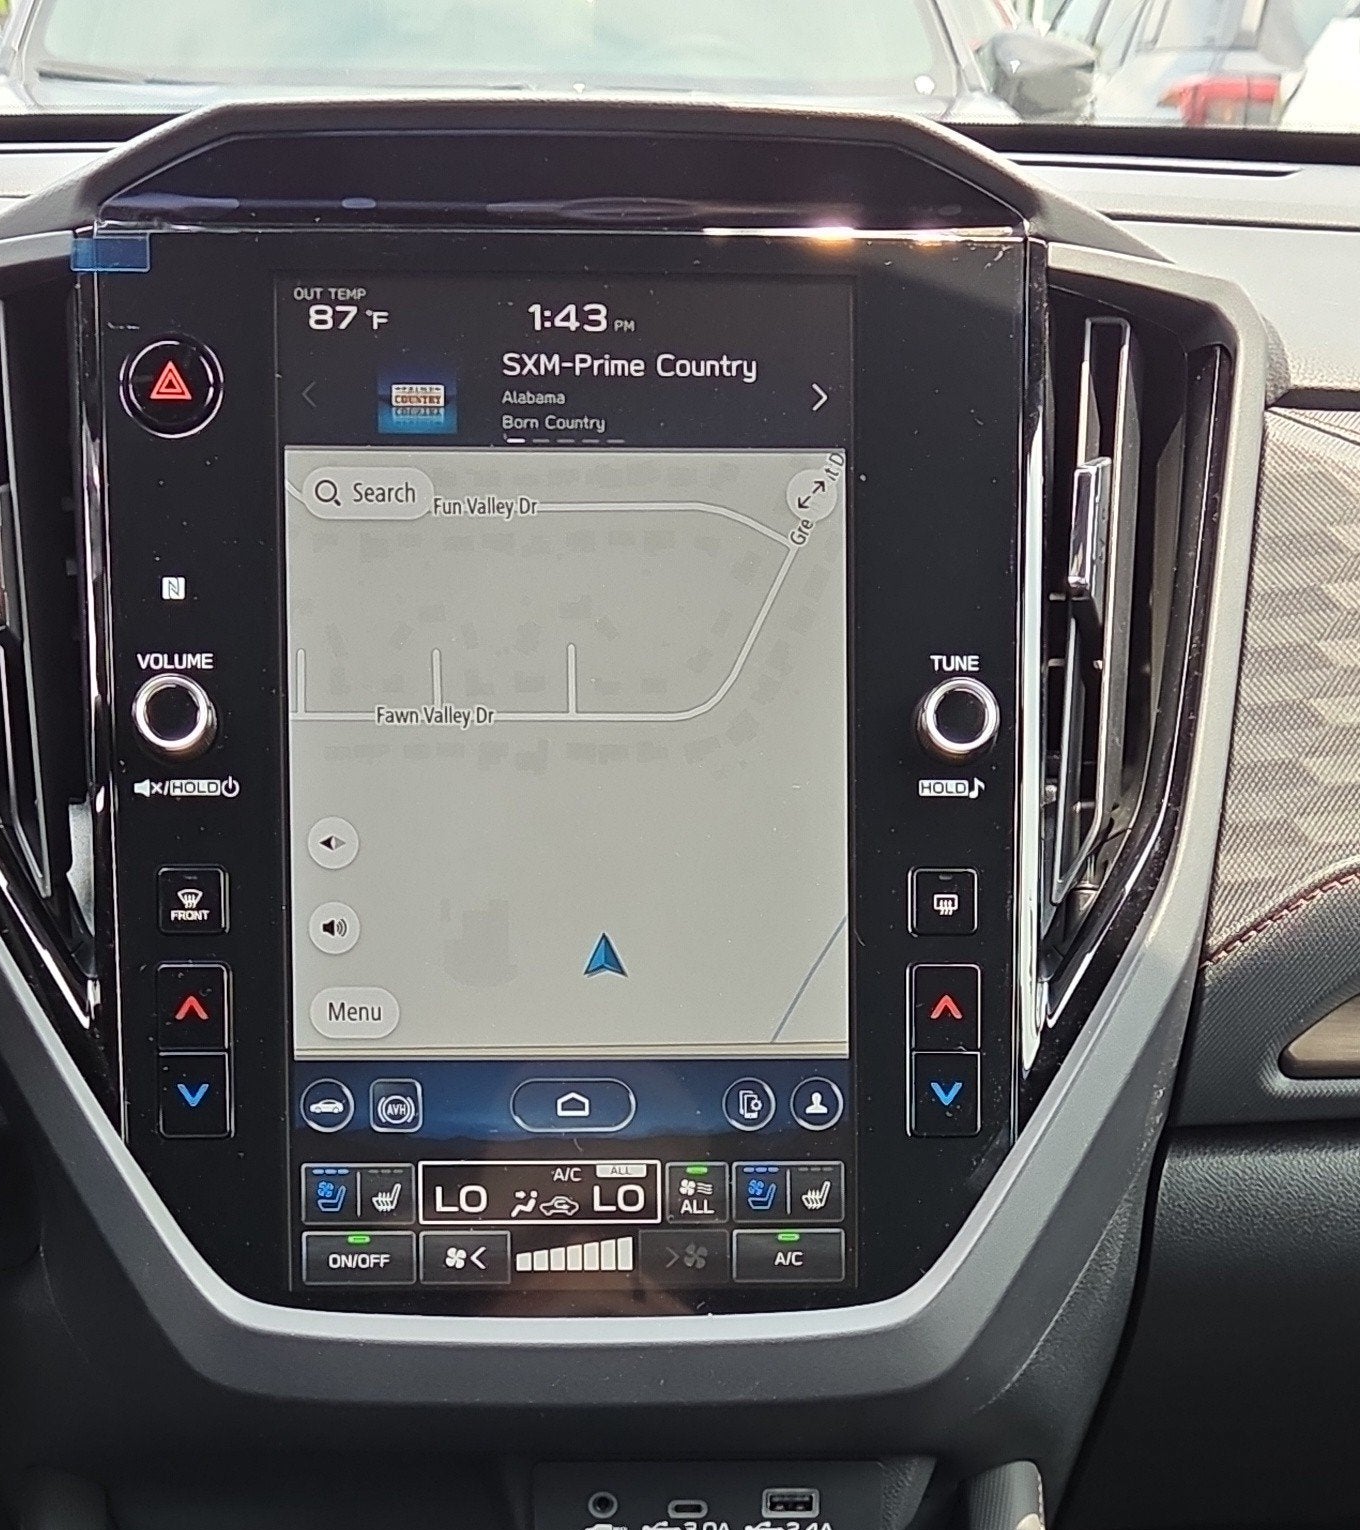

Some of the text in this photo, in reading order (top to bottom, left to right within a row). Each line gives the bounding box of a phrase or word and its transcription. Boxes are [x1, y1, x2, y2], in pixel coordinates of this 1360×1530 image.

[294, 287, 366, 301] OUT TEMP
[308, 303, 358, 331] 87
[528, 303, 636, 332] 1:43 PM
[502, 352, 758, 383] SXM-Prime Country
[502, 391, 566, 405] Alabama
[502, 415, 606, 434] Born Country
[353, 482, 415, 503] Search
[433, 497, 537, 519] Fun Valley Dr
[137, 653, 214, 670] VOLUME
[930, 655, 980, 672] TUNE
[377, 706, 494, 729] Fawn Valley Dr
[171, 780, 220, 796] HOLD
[920, 780, 968, 796] HOLD
[170, 909, 210, 921] FRONT
[328, 1002, 381, 1021] Menu
[386, 1103, 407, 1116] AVH
[552, 1167, 582, 1182] A/C
[610, 1166, 634, 1176] ALL
[435, 1185, 488, 1212] LO
[593, 1184, 645, 1212] LO
[680, 1199, 715, 1214] ALL
[328, 1253, 391, 1269] ON/OFF
[774, 1251, 804, 1266] A/C
